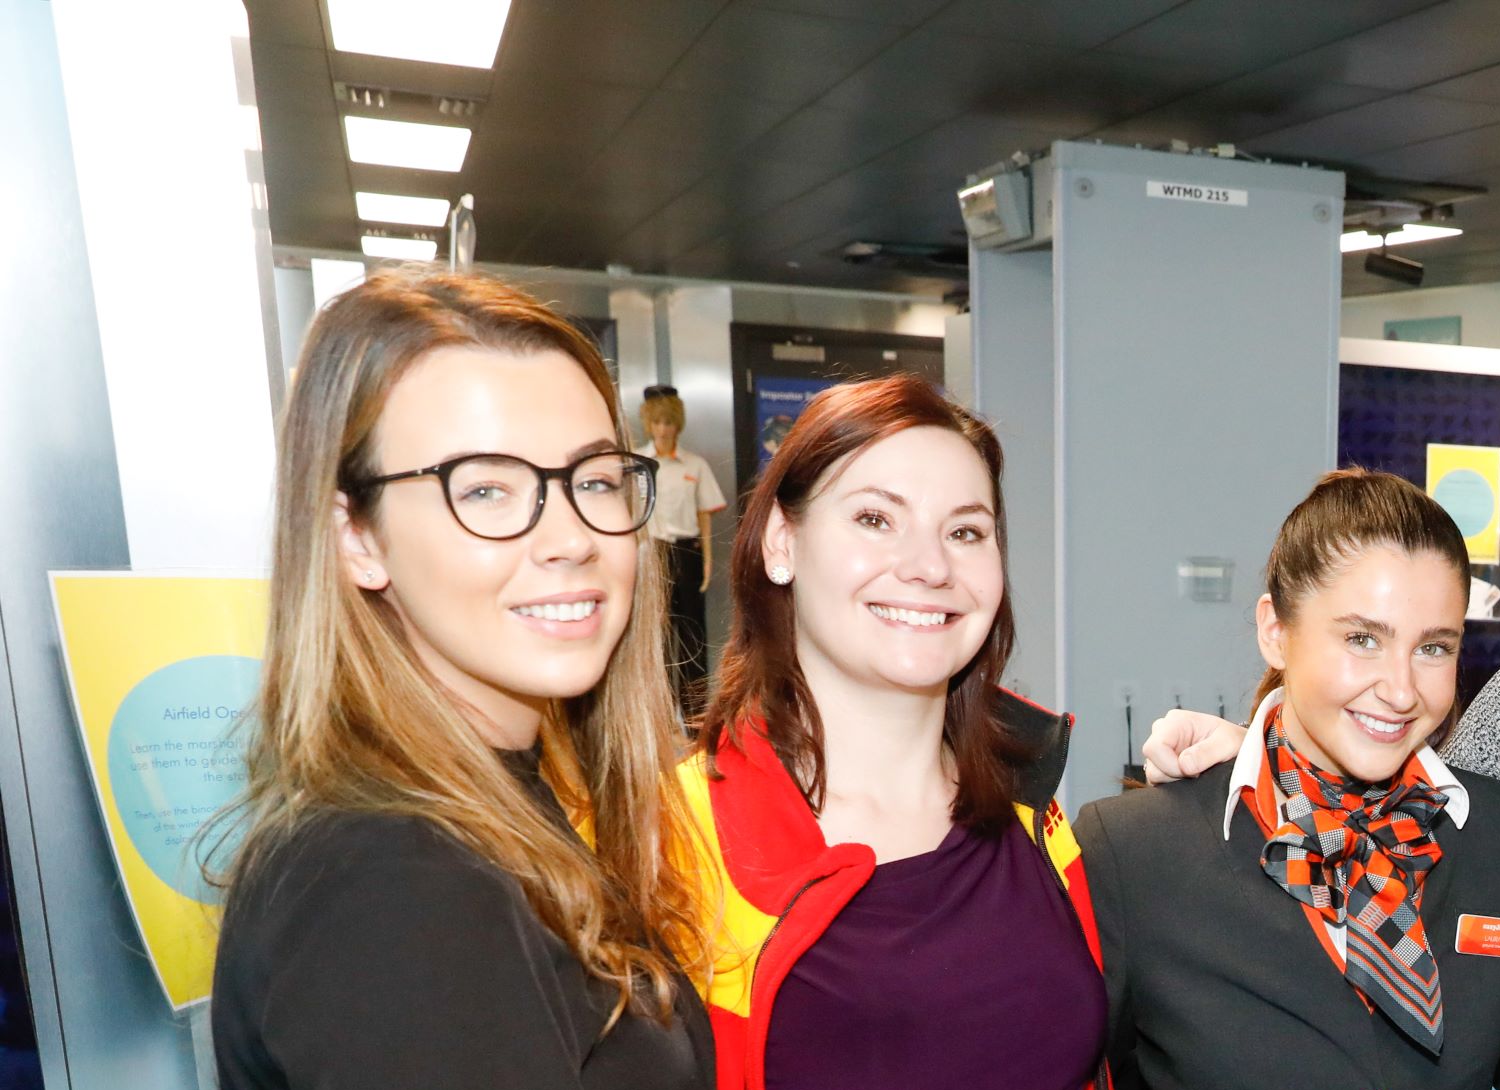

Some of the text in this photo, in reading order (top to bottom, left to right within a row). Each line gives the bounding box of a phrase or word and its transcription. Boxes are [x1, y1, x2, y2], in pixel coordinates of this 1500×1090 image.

[1163, 184, 1229, 202] WTMD 215
[163, 706, 210, 720] Airfield
[165, 739, 183, 751] the
[152, 757, 181, 768] them
[184, 757, 197, 767] to
[203, 771, 223, 782] the
[174, 806, 188, 816] the
